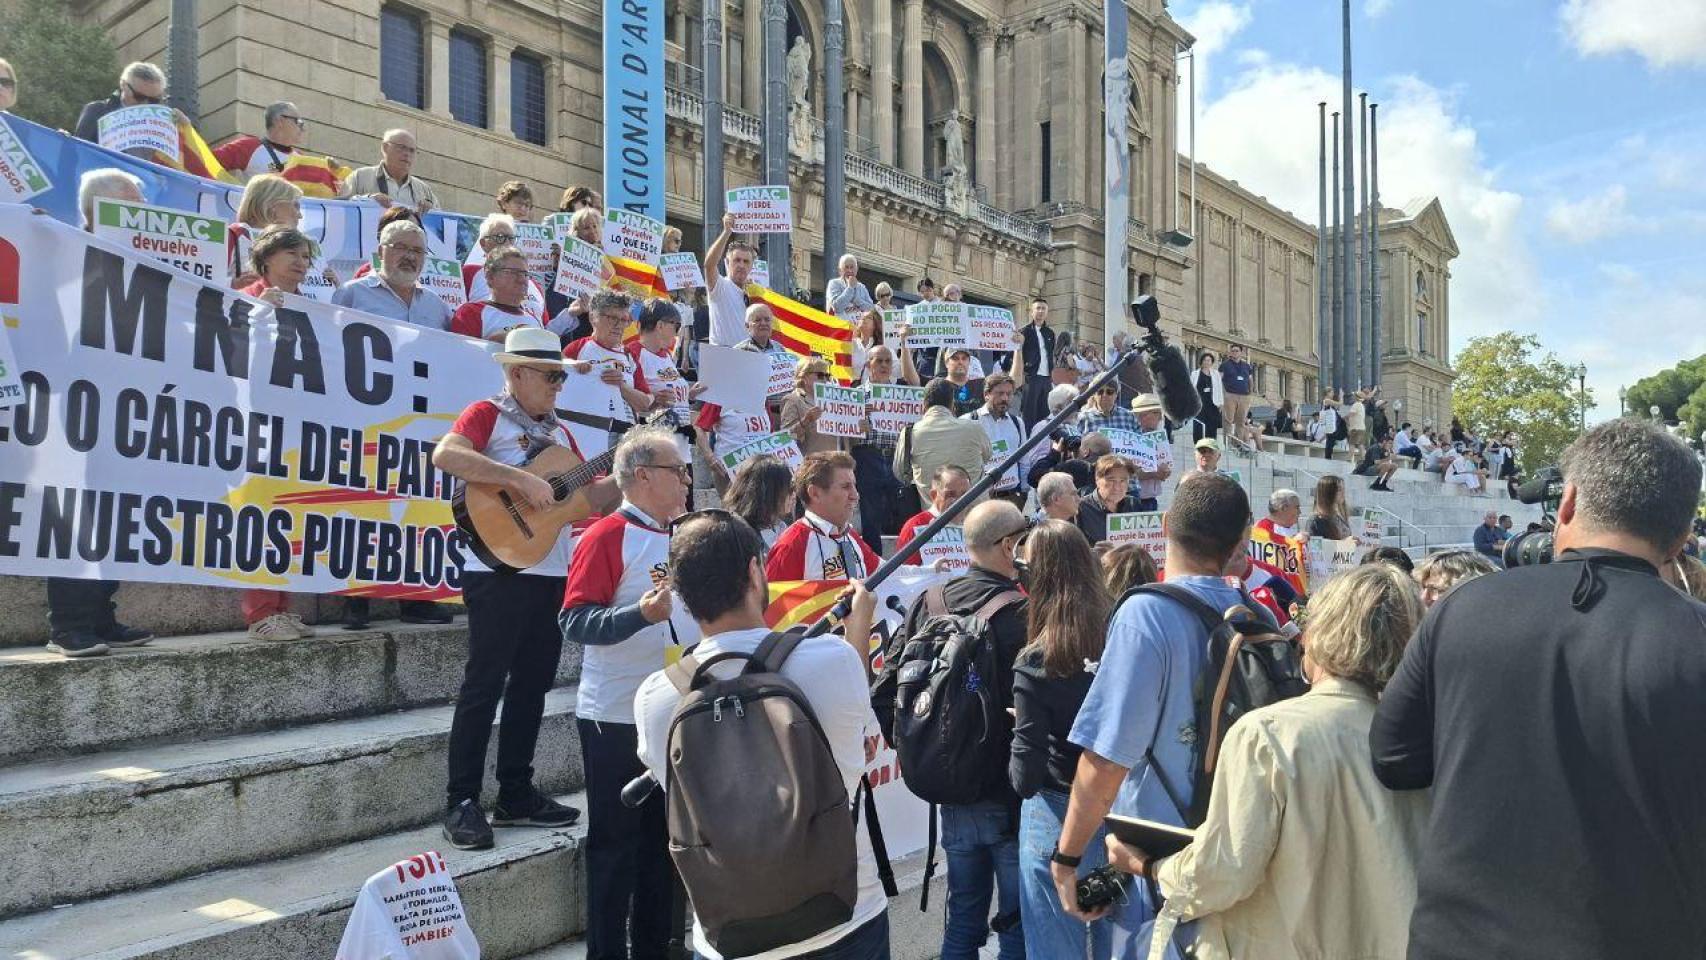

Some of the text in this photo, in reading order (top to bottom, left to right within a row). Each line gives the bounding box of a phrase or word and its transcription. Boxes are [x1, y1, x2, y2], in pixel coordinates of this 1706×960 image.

[622, 89, 650, 216] ACIONAL
[737, 189, 780, 200] MNAC
[120, 206, 211, 241] MNAC
[618, 211, 662, 235] MNAC
[132, 233, 198, 256] devuelve
[611, 234, 622, 244] LO
[623, 237, 639, 249] QUE
[640, 241, 649, 252] ES
[193, 262, 213, 280] DE
[931, 304, 961, 312] POCOS
[975, 308, 1012, 320] MNAC
[912, 315, 960, 325] NO RESTA
[908, 327, 961, 335] DERECHOS
[823, 387, 859, 402] MNAC
[881, 387, 925, 401] MNAC
[829, 402, 863, 416] JUSTICIA
[874, 419, 892, 431] NOS
[66, 379, 100, 453] O
[115, 384, 289, 478] CÁRCEL
[300, 421, 368, 489] DEL
[36, 485, 293, 575] NUESTROS
[302, 513, 467, 589] PUEBLOS
[1109, 531, 1137, 542] cumple
[1138, 530, 1146, 539] la
[1152, 542, 1166, 552] del
[421, 907, 433, 917] DE
[419, 918, 431, 928] DE
